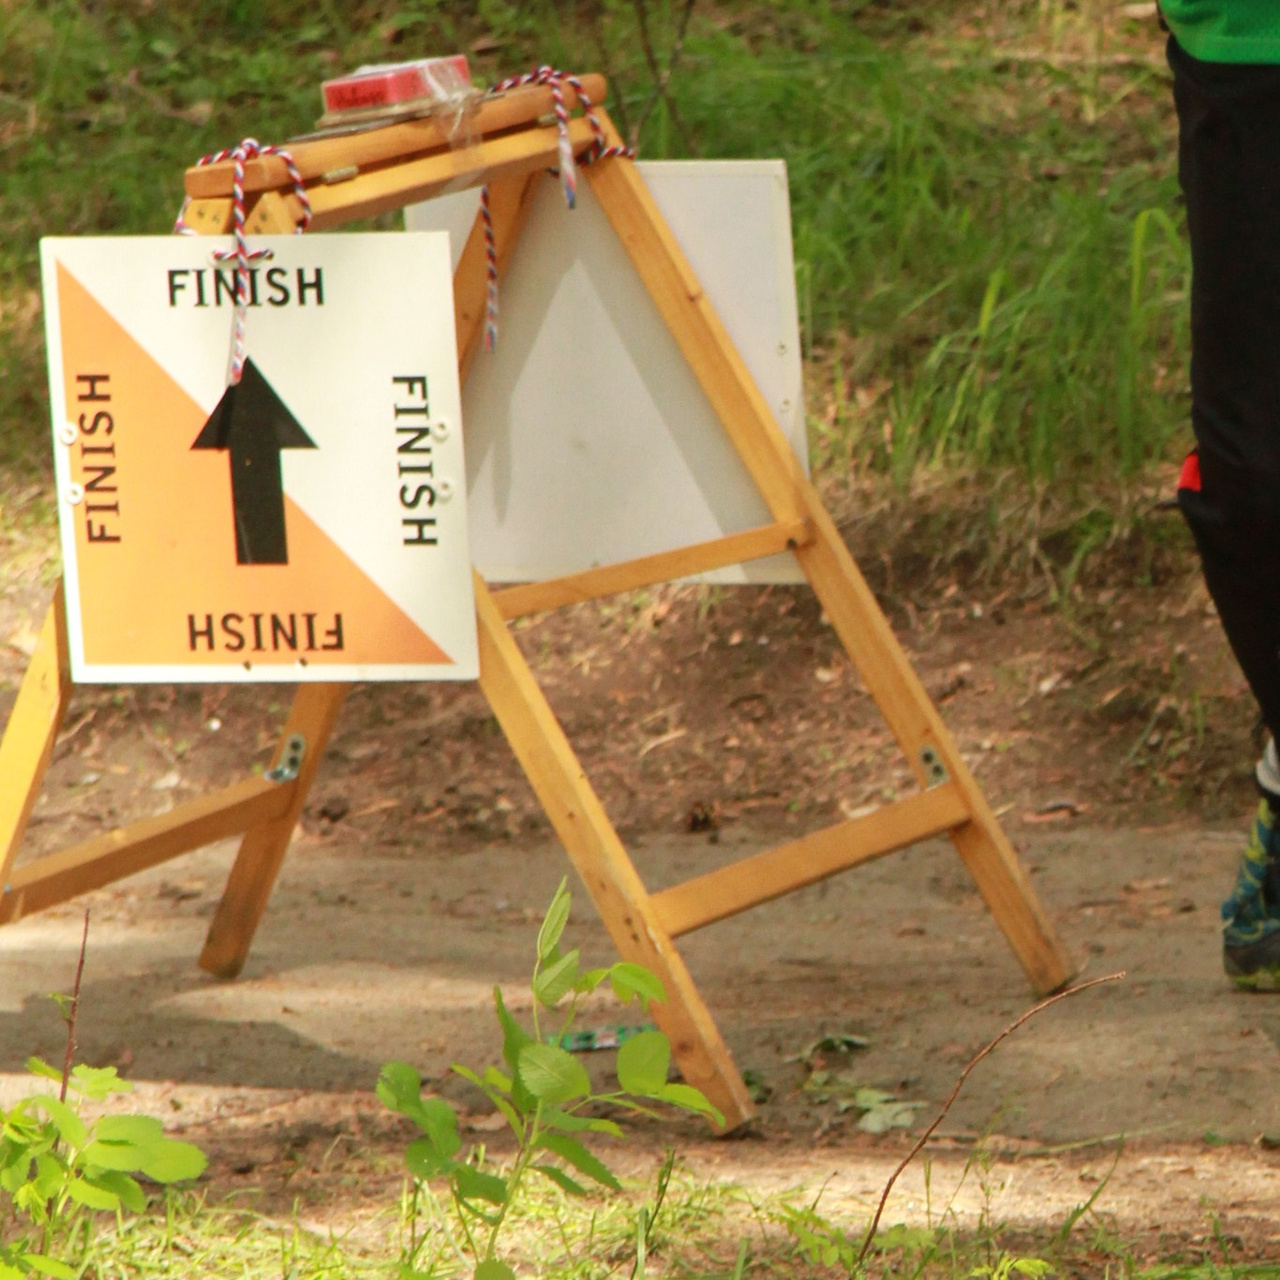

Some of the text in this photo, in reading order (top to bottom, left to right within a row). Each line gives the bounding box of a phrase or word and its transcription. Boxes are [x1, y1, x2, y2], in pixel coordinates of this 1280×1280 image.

[167, 267, 325, 307] FINISH
[76, 373, 121, 543] FINISH
[392, 375, 438, 547] FINISH
[187, 613, 344, 651] FINISH
